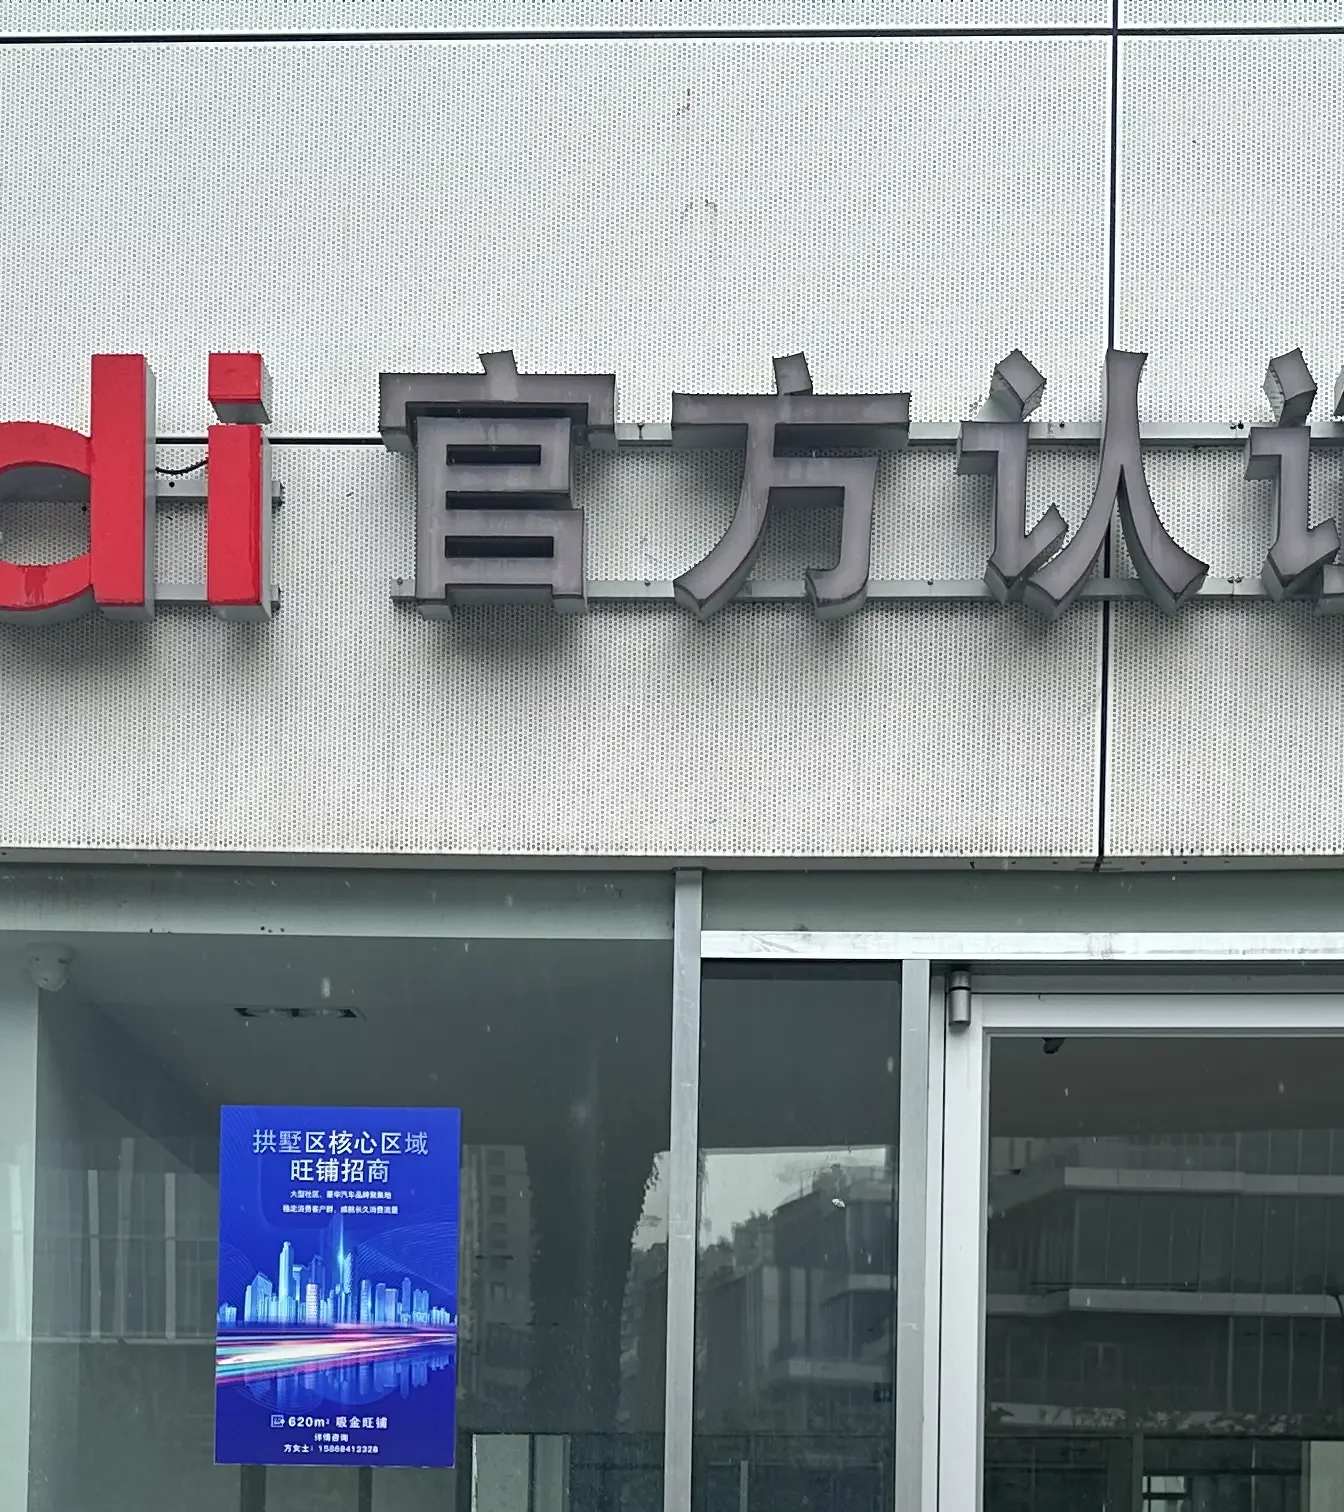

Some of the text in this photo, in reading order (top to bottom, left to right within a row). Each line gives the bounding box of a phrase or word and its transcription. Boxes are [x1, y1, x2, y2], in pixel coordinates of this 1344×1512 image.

[253, 1129, 428, 1156] 拱墅区核心区域
[290, 1157, 390, 1184] 旺铺招商
[336, 1415, 388, 1429] 吸金旺铺
